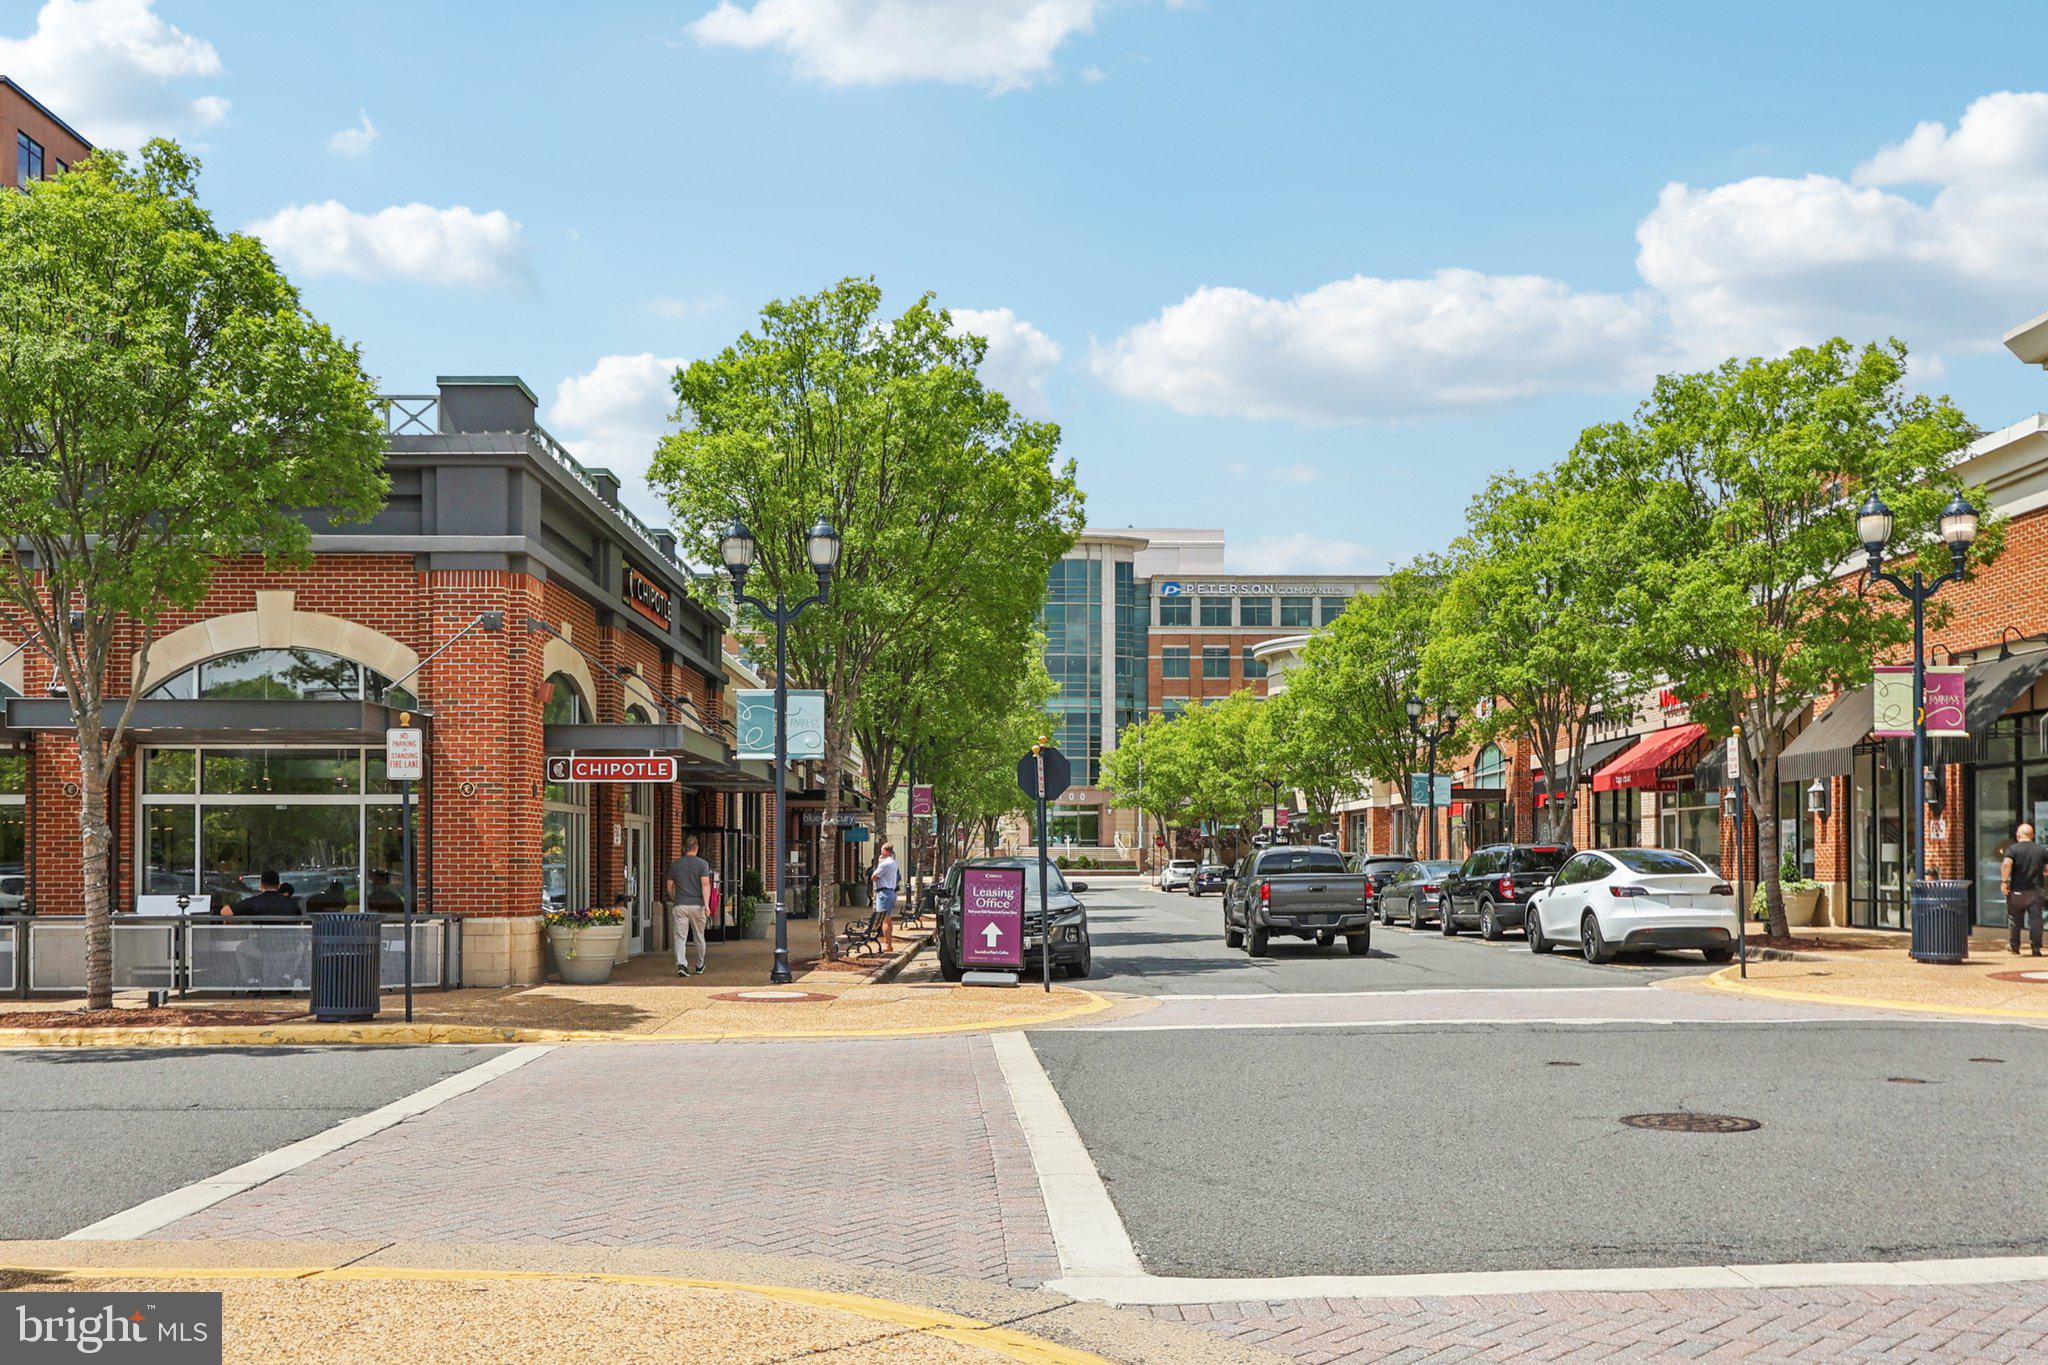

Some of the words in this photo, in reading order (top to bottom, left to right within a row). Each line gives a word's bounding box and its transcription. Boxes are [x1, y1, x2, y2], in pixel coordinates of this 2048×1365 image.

[1186, 584, 1274, 594] PETERSON
[1277, 586, 1345, 595] COMPANIES
[637, 578, 672, 621] CHIPOTLE
[1929, 694, 1960, 702] FAIRFAX
[400, 732, 408, 740] NO
[392, 740, 417, 748] PARKING
[390, 752, 419, 760] STANDING
[389, 760, 402, 768] FIRE
[404, 760, 419, 768] LANE
[576, 763, 668, 776] CHIPOTLE
[972, 886, 1014, 901] Leasing
[975, 897, 1010, 908] Office
